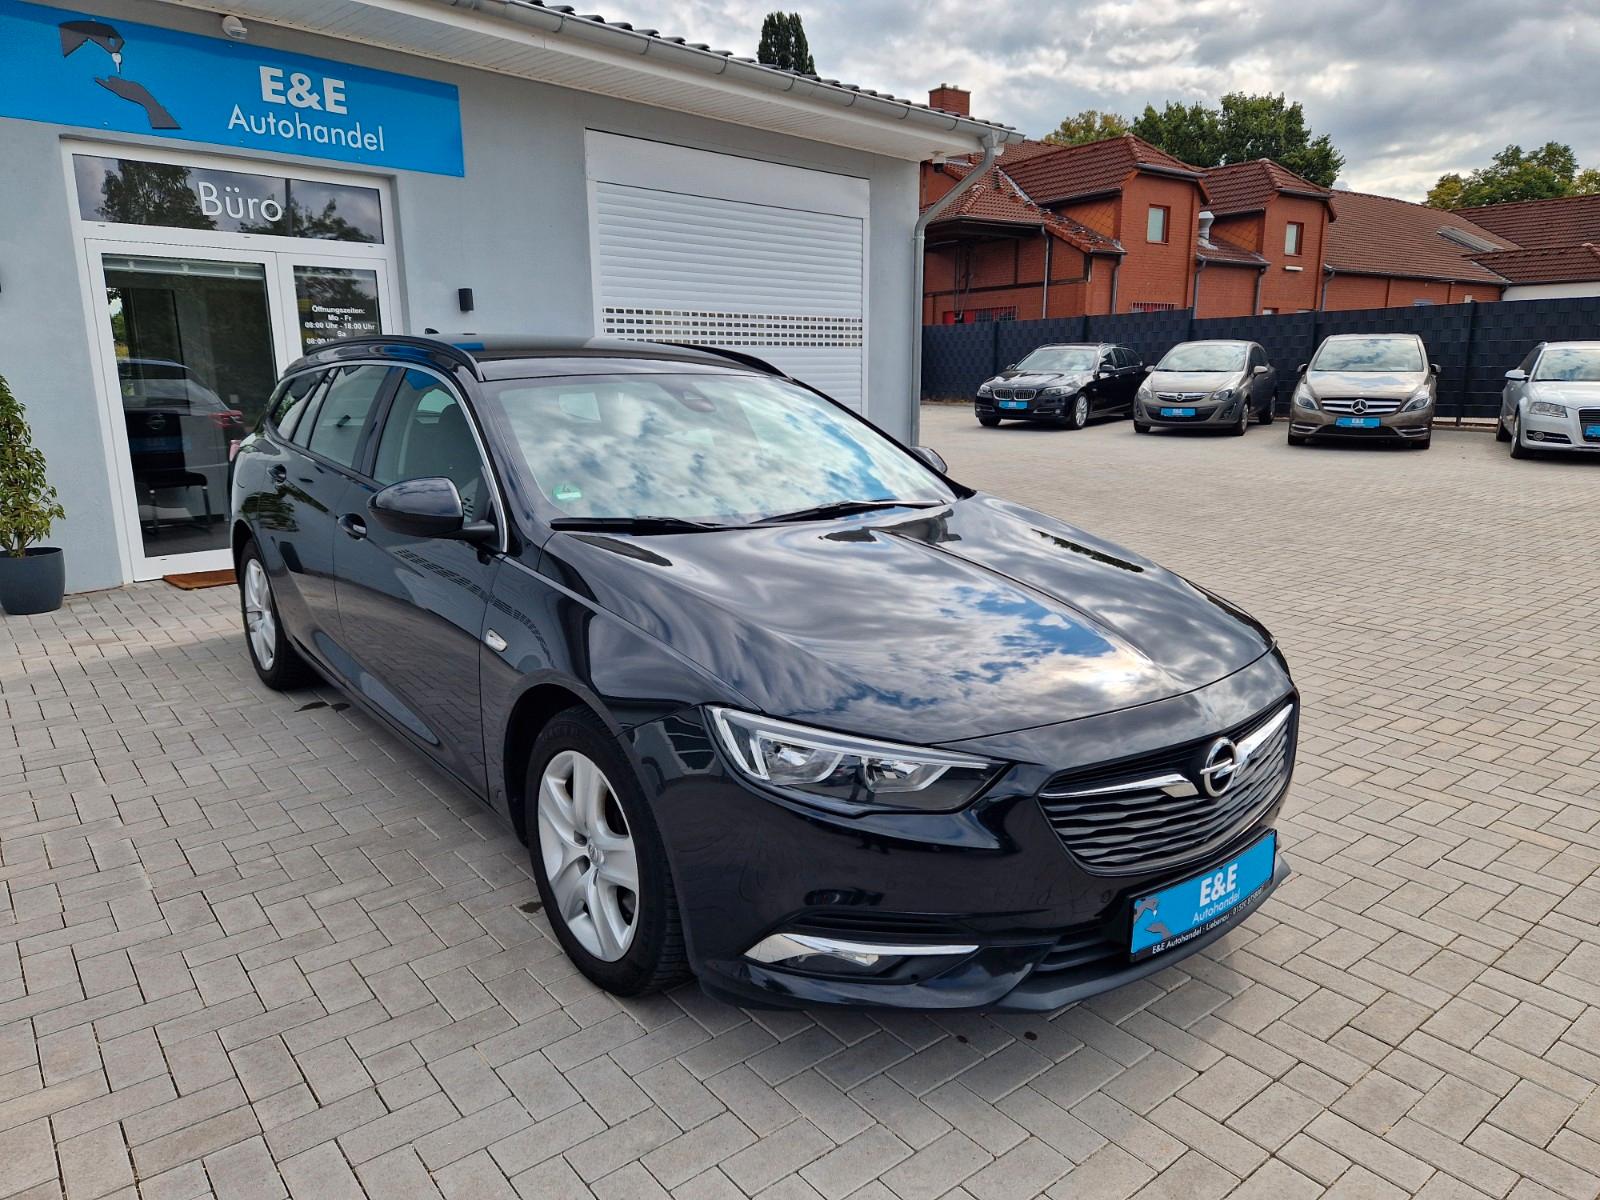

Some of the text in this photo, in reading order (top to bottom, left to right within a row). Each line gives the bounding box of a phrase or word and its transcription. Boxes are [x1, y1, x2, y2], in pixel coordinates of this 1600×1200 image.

[259, 65, 348, 115] E&E
[227, 103, 385, 152] Autohandel
[198, 181, 283, 222] Büro
[344, 314, 352, 322] Fr
[1200, 863, 1238, 907] E&E
[1191, 888, 1240, 925] Autohandel
[1152, 942, 1166, 954] E&E
[1166, 927, 1201, 948] Autohandel
